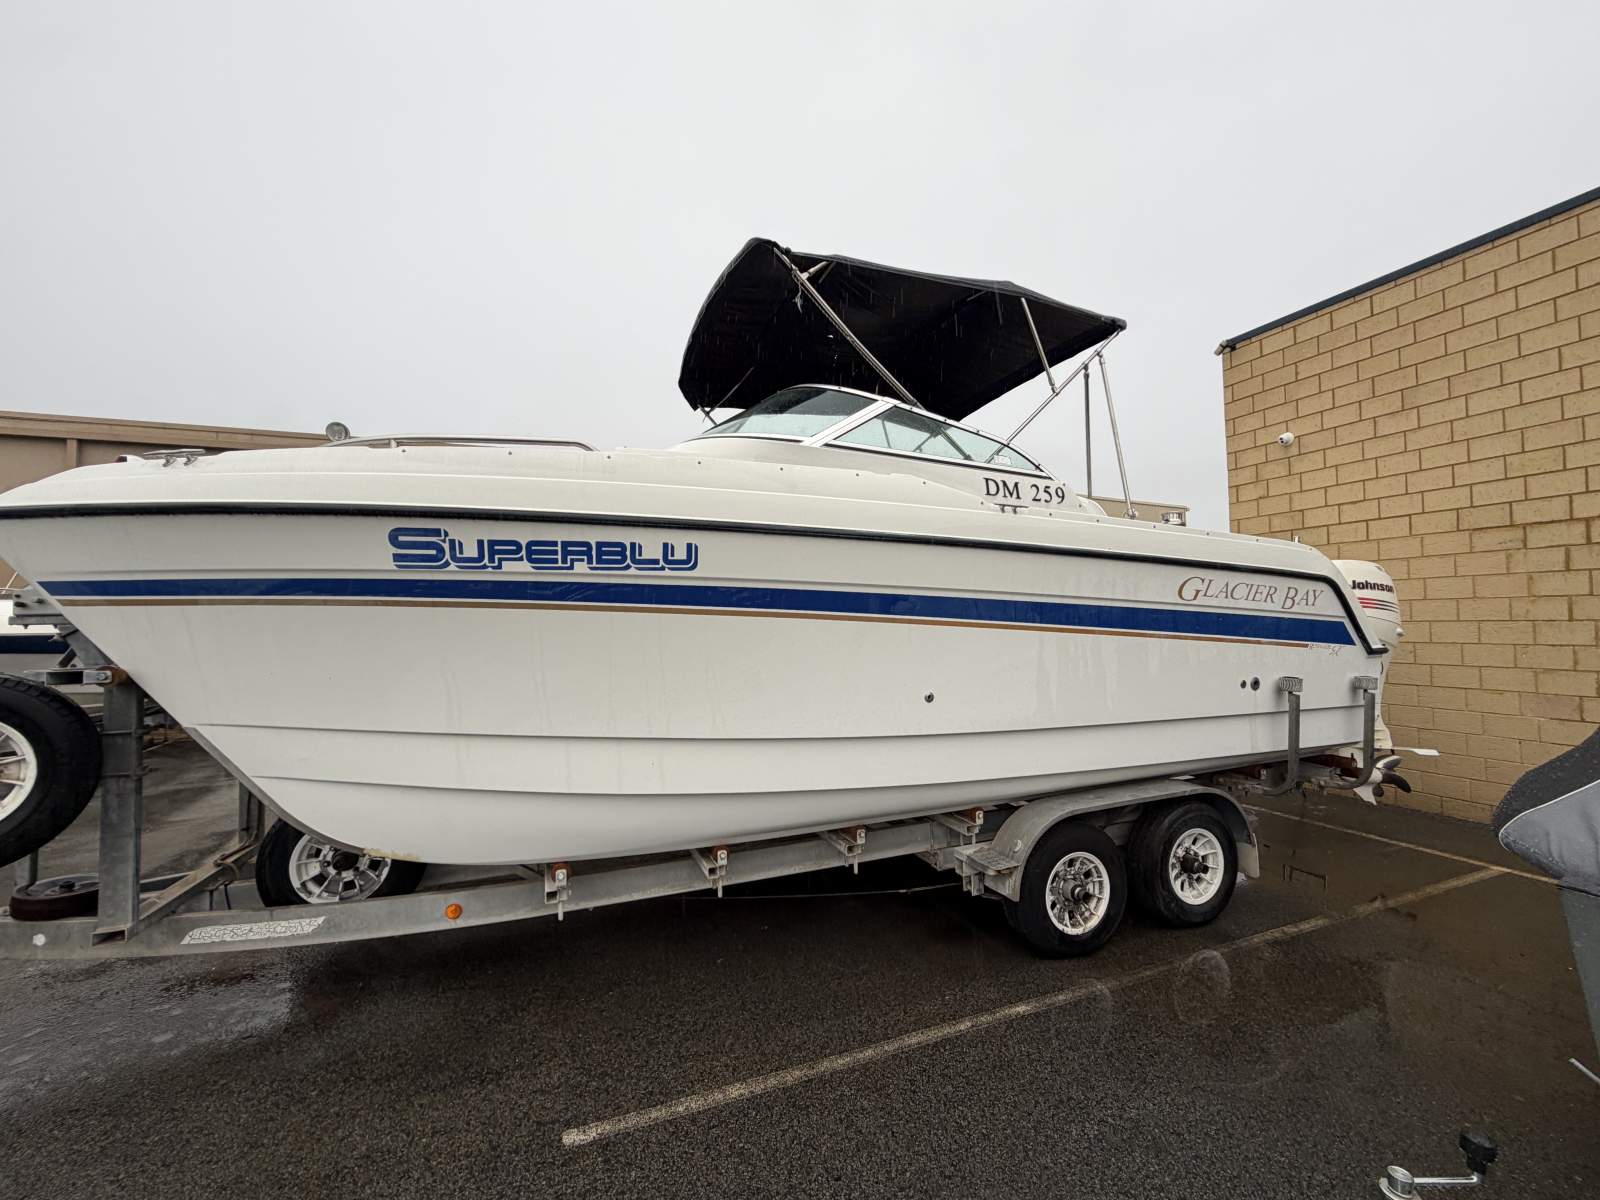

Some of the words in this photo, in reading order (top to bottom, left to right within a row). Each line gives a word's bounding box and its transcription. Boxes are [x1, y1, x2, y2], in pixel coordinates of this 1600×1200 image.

[983, 477, 1021, 499] DM
[1030, 484, 1065, 504] 259
[388, 527, 698, 571] SUPERBLU
[1178, 576, 1278, 603] GLACIER
[1282, 586, 1323, 610] BAY
